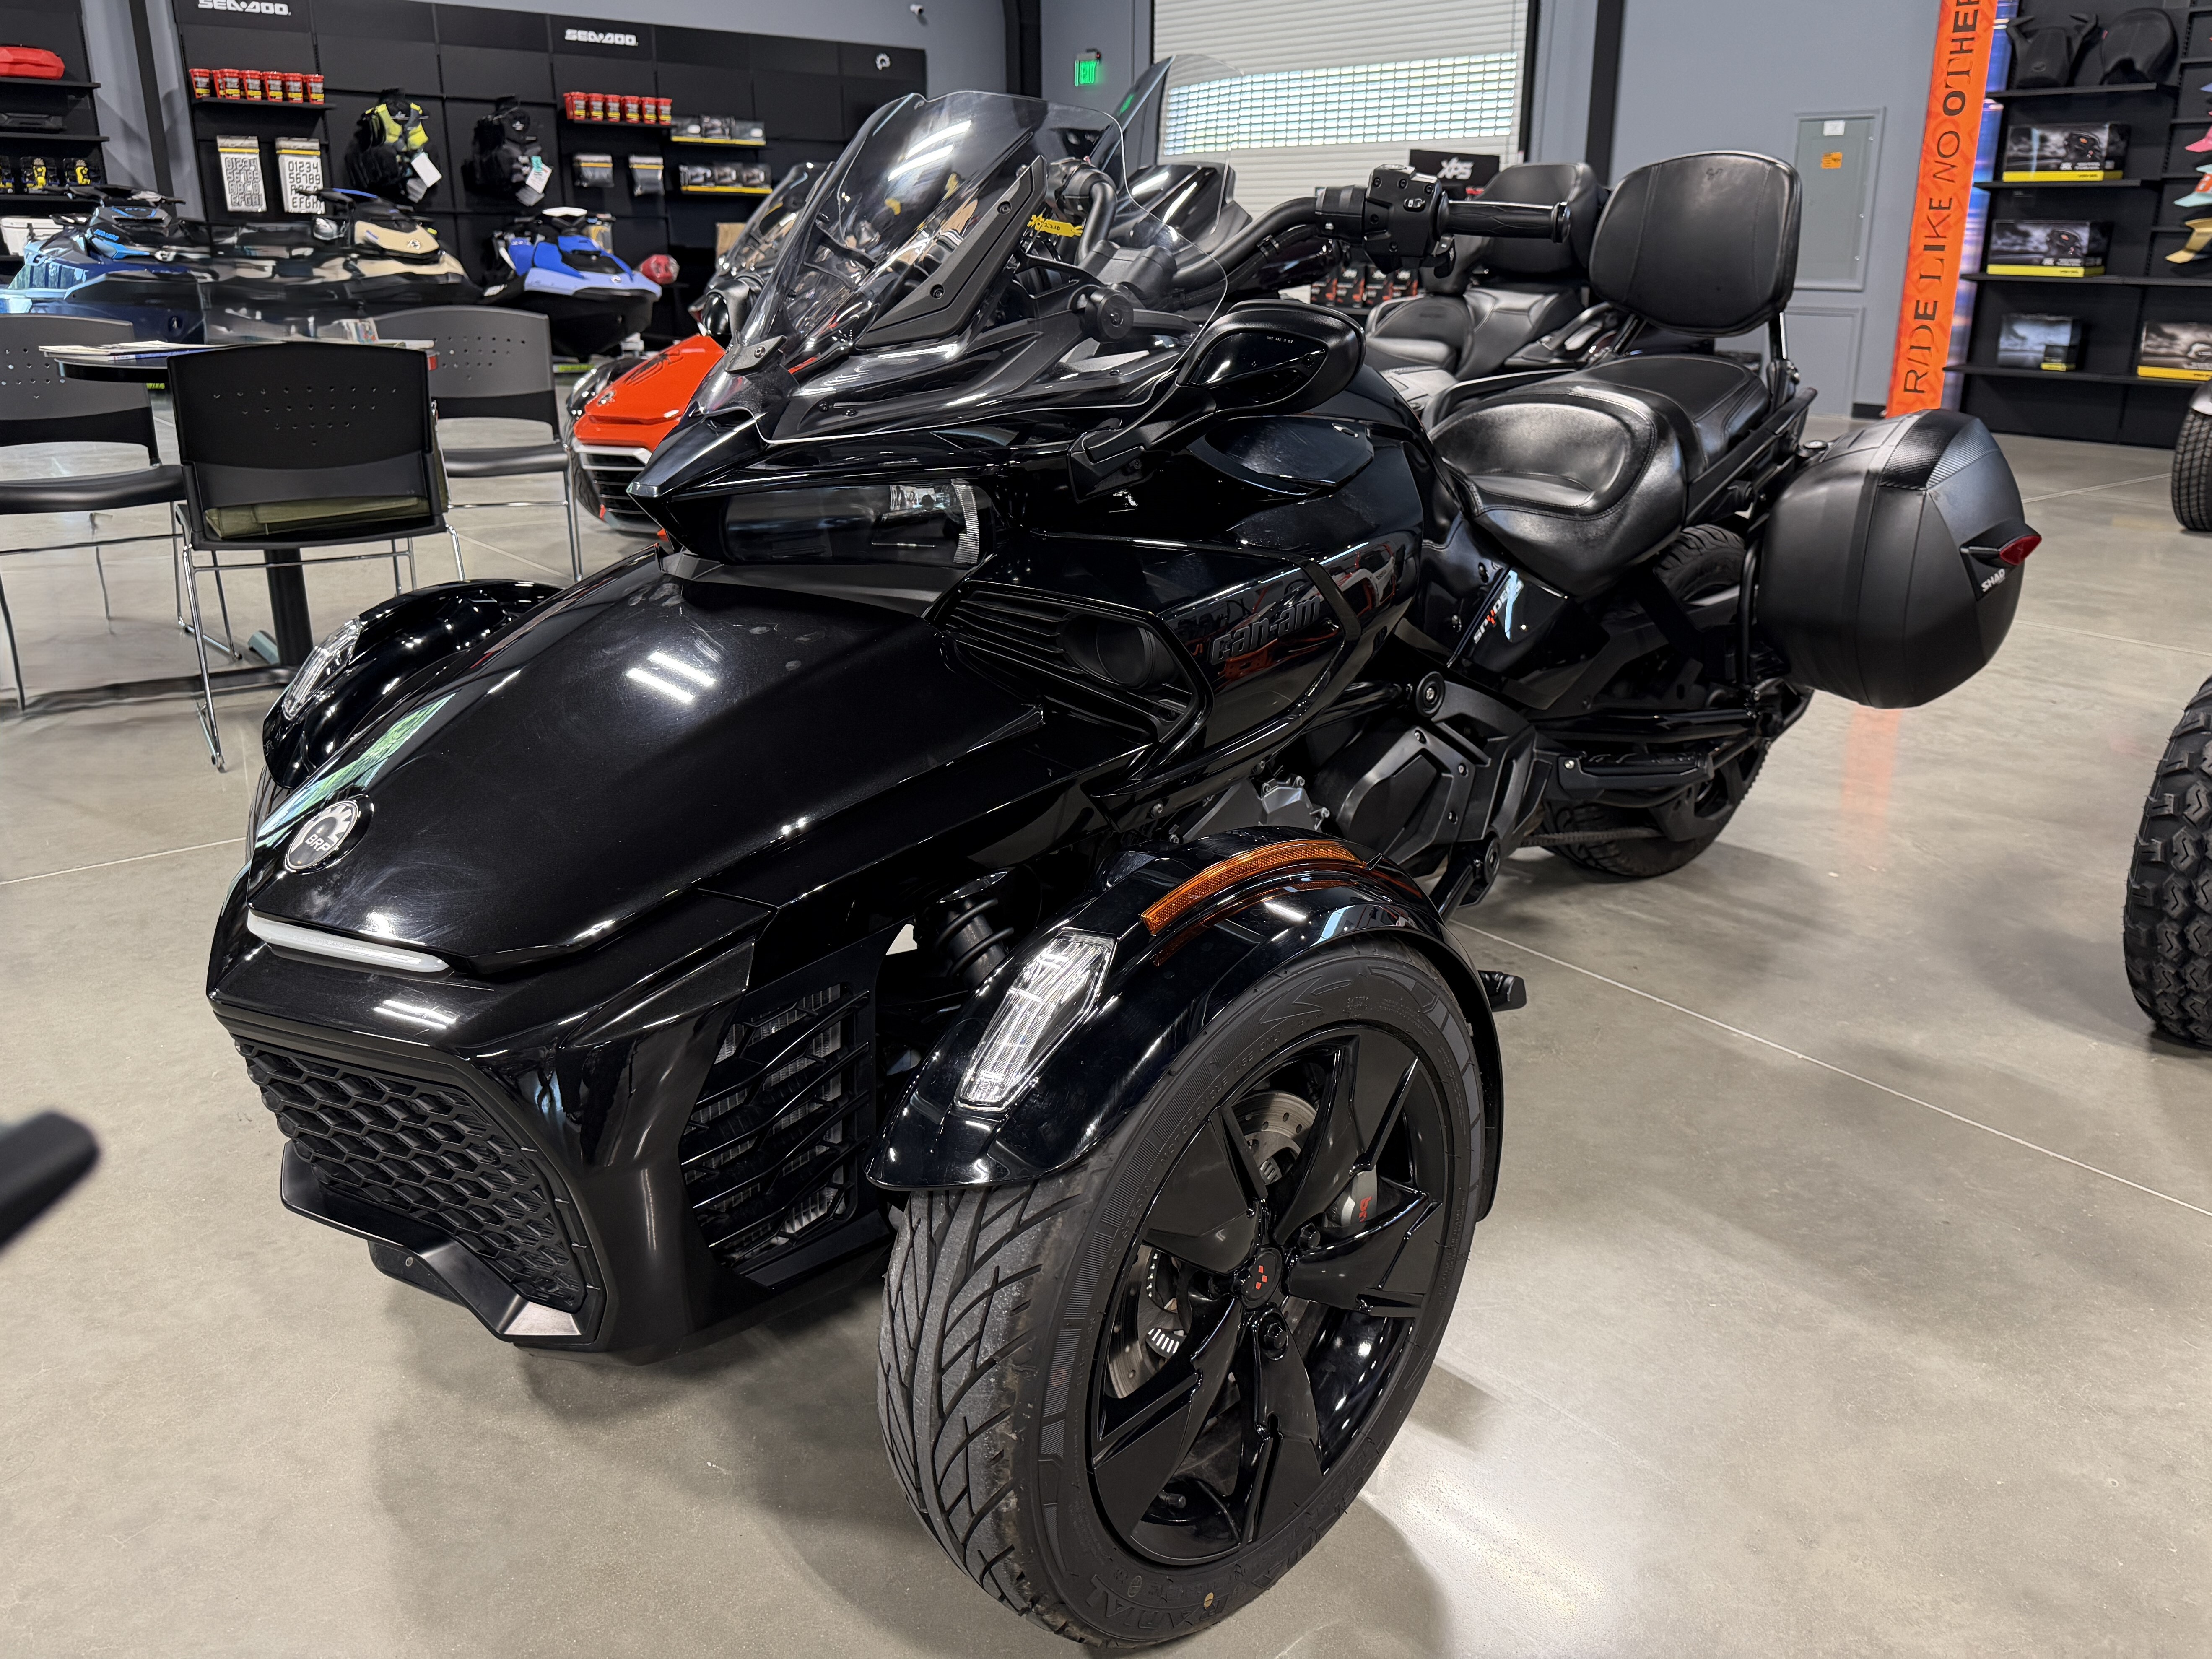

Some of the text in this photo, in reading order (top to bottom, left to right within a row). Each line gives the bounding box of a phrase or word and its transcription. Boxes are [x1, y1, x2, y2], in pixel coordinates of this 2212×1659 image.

[288, 161, 319, 172] 01234
[289, 172, 321, 184] 56789
[1437, 156, 1475, 180] XPS
[1933, 130, 1960, 184] NO
[1917, 197, 1952, 286] LIKE
[1903, 299, 1938, 394] RIDE
[1981, 568, 2005, 592] SHAD
[1211, 595, 1320, 665] can-am
[305, 833, 331, 852] BRP
[1103, 1027, 1285, 1281] FOR SPECIAL MOTORCYCLE USE ONLY
[1084, 1573, 1229, 1630] RADIAL
